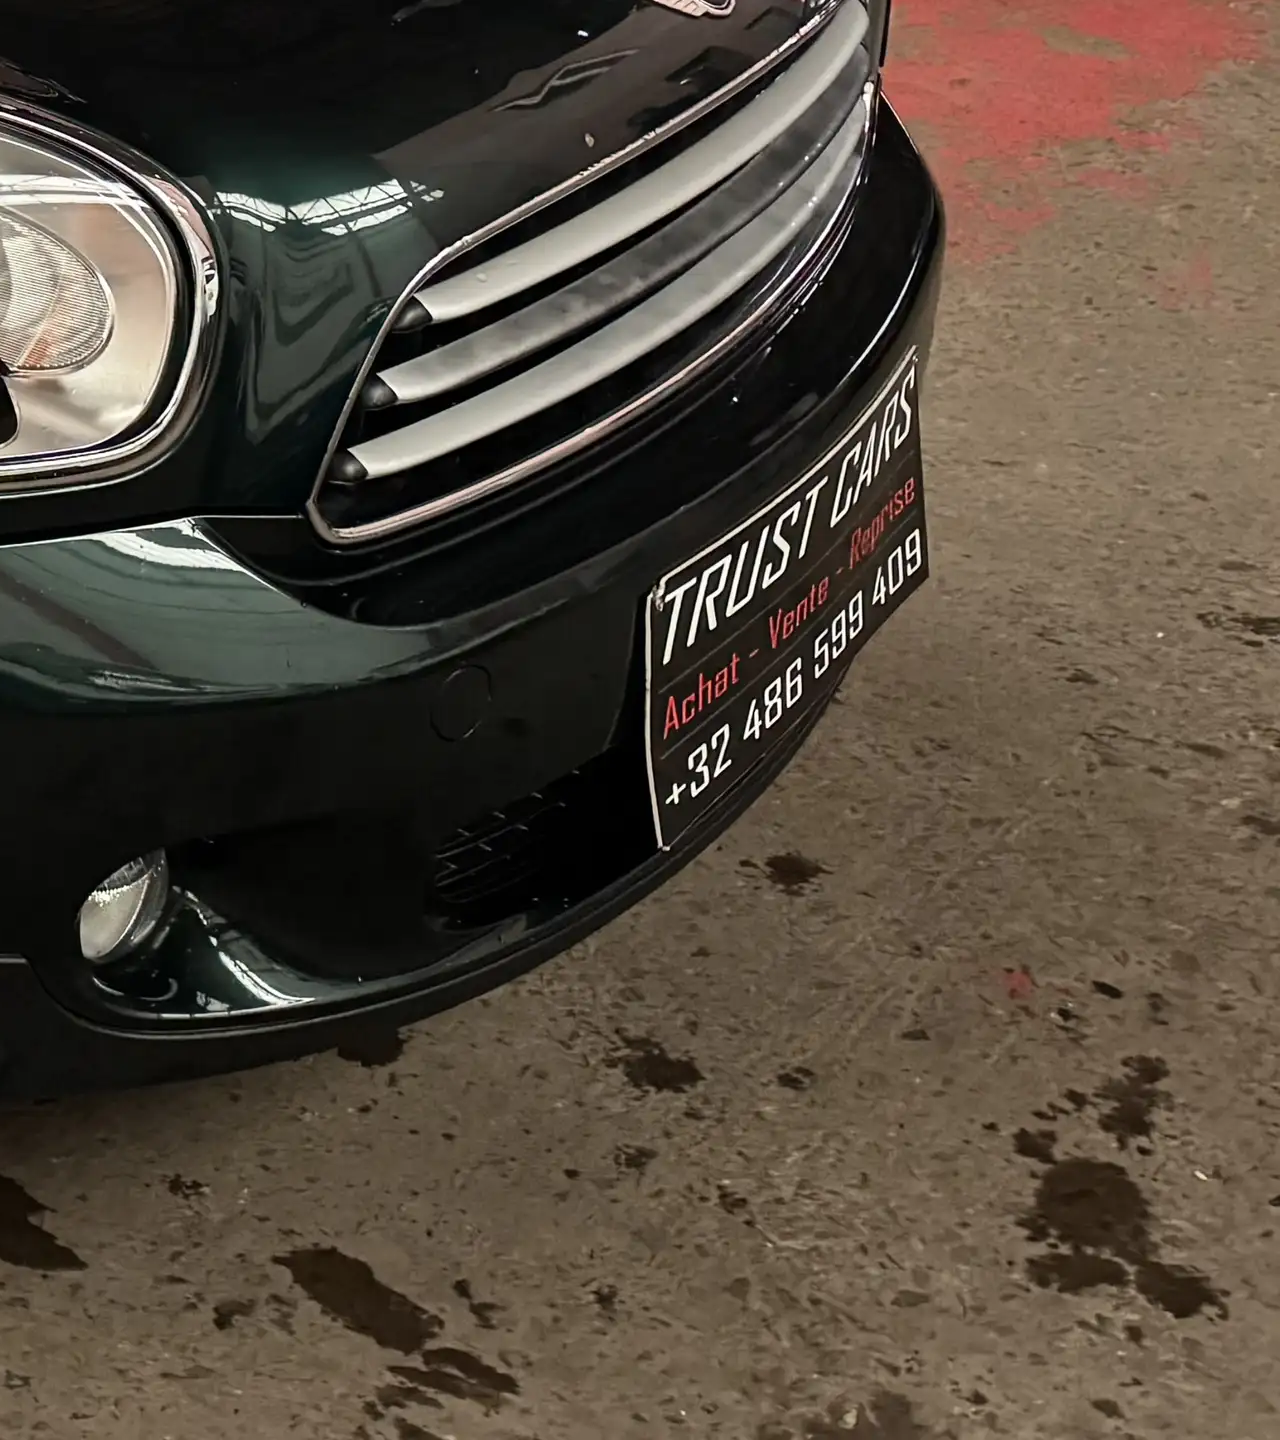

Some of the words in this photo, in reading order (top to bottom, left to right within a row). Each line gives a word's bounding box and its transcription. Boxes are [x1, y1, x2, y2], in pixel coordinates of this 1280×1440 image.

[662, 475, 829, 666] TRUST
[830, 365, 915, 528] CARS
[662, 652, 740, 741] Achat
[768, 576, 830, 649] Vente
[849, 477, 915, 570] Reprise
[665, 723, 733, 805] +32
[742, 656, 804, 741] 486
[813, 590, 864, 679] 599
[872, 528, 923, 606] 409
